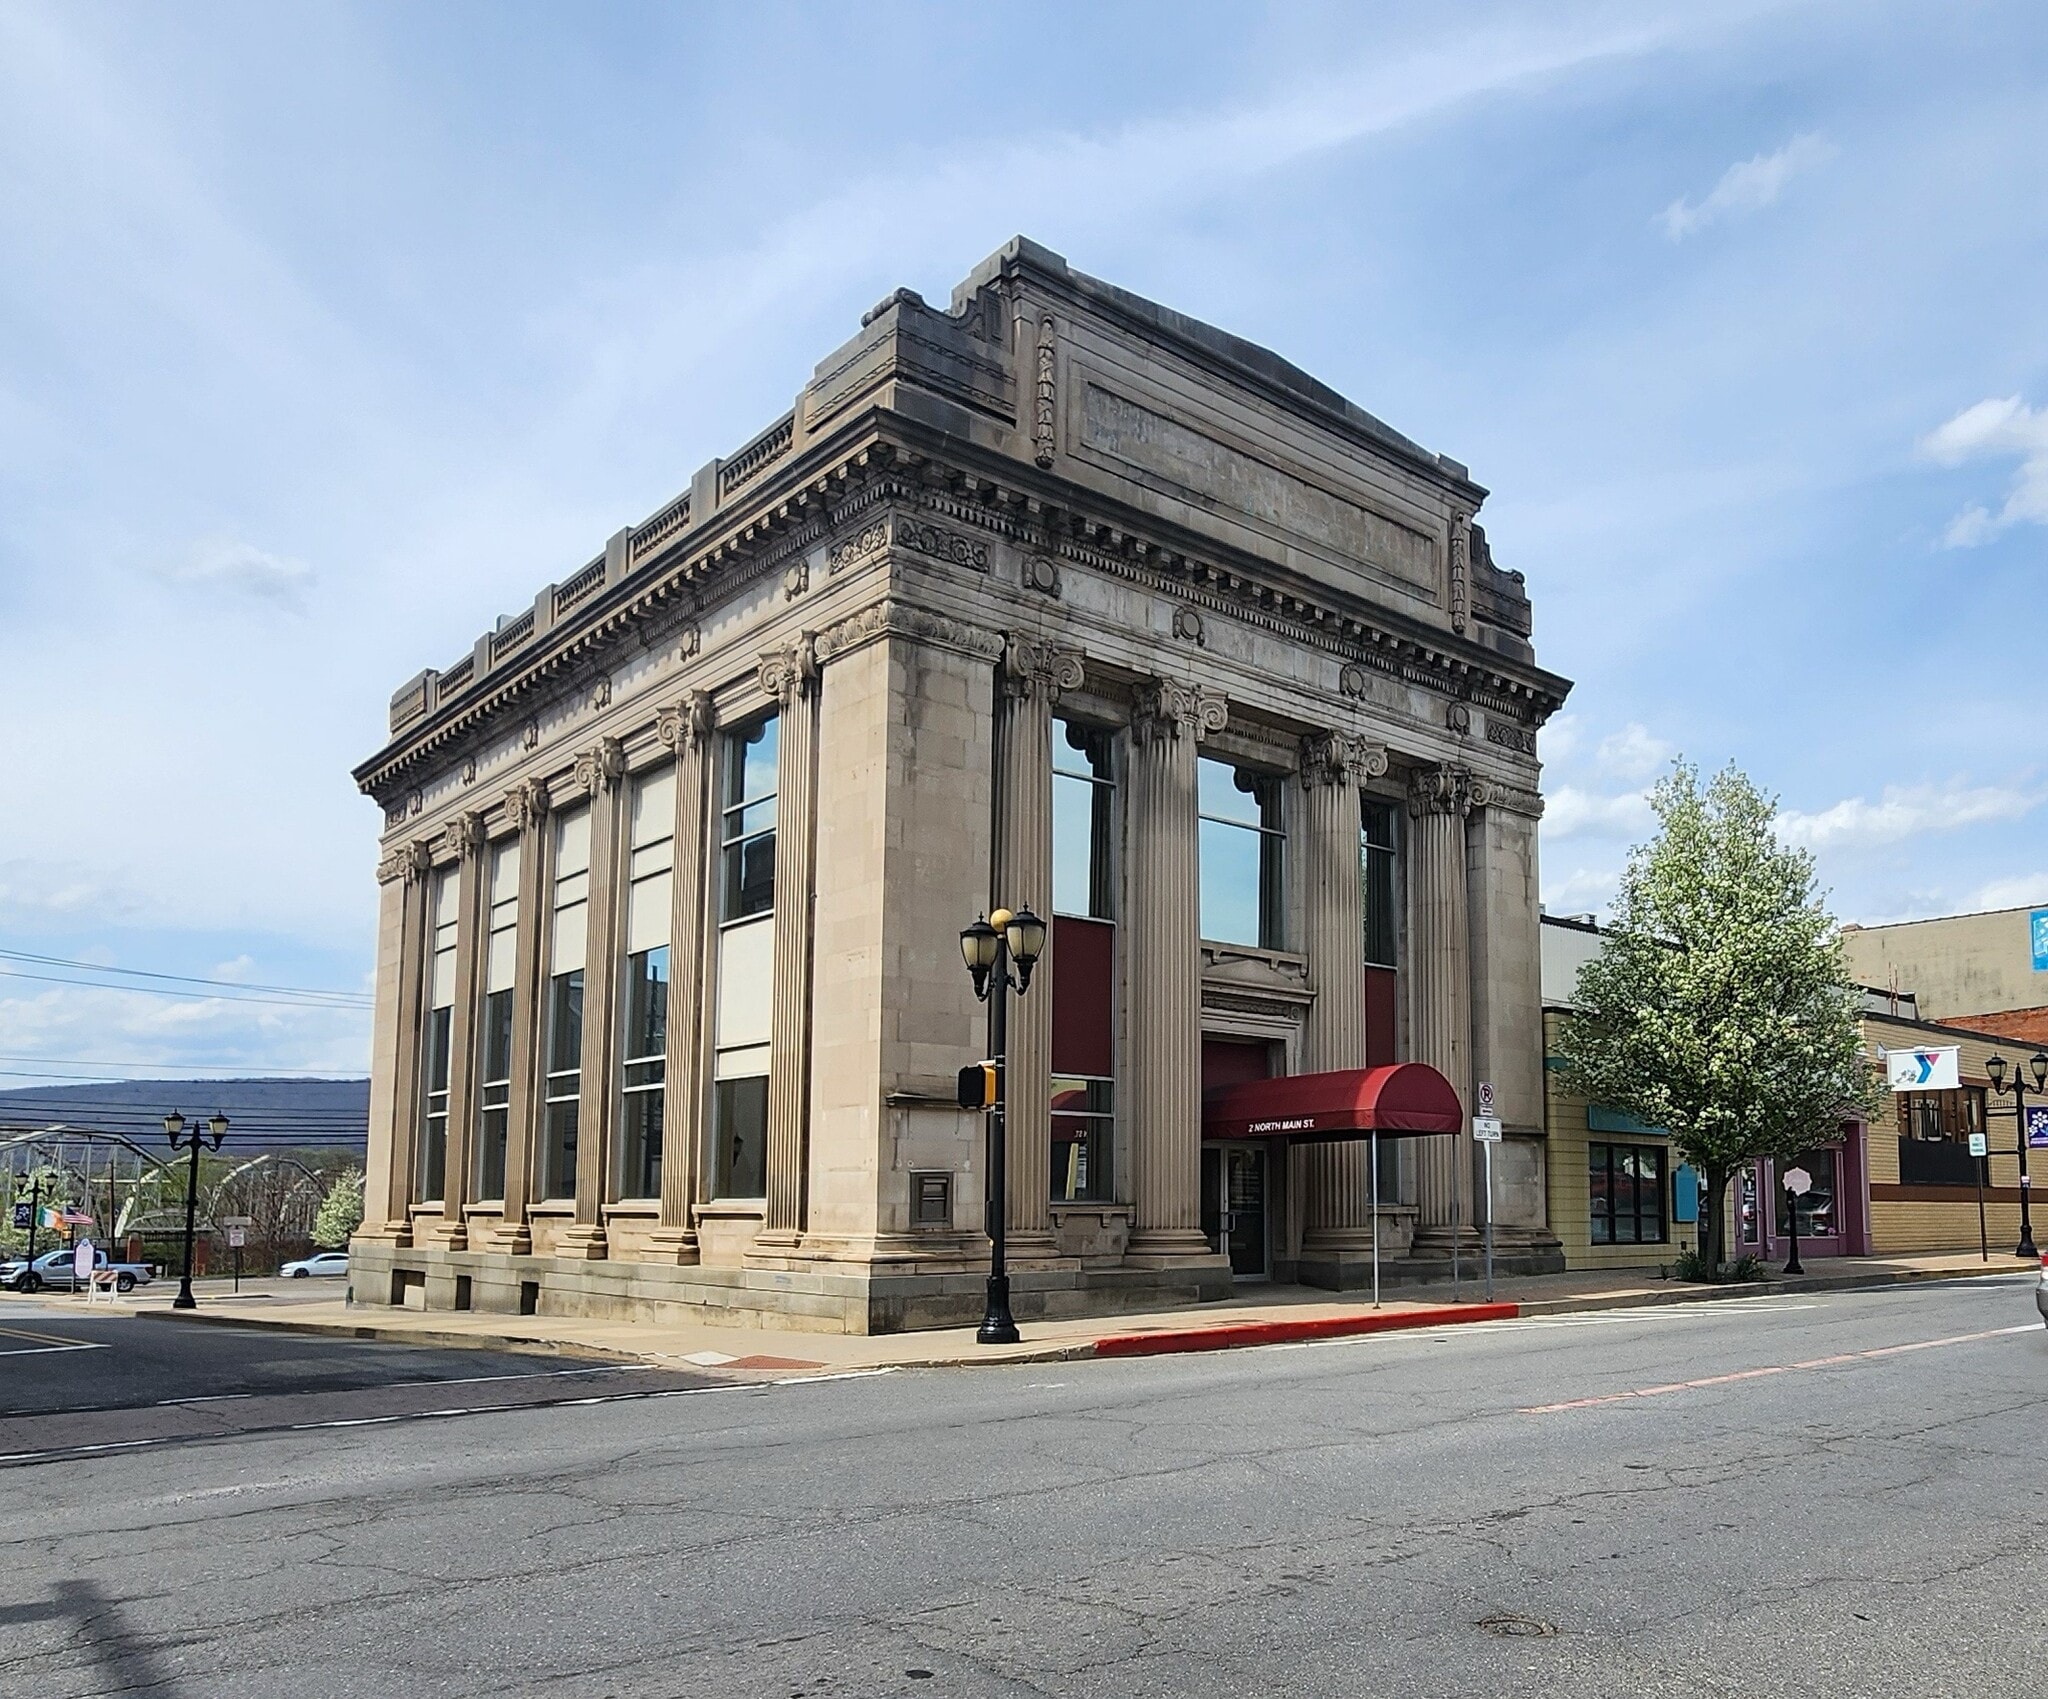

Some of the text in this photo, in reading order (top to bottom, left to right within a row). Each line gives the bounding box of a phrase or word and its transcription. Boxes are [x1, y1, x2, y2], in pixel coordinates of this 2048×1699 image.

[1248, 1118, 1315, 1133] 2 NORTH MAIN ST.
